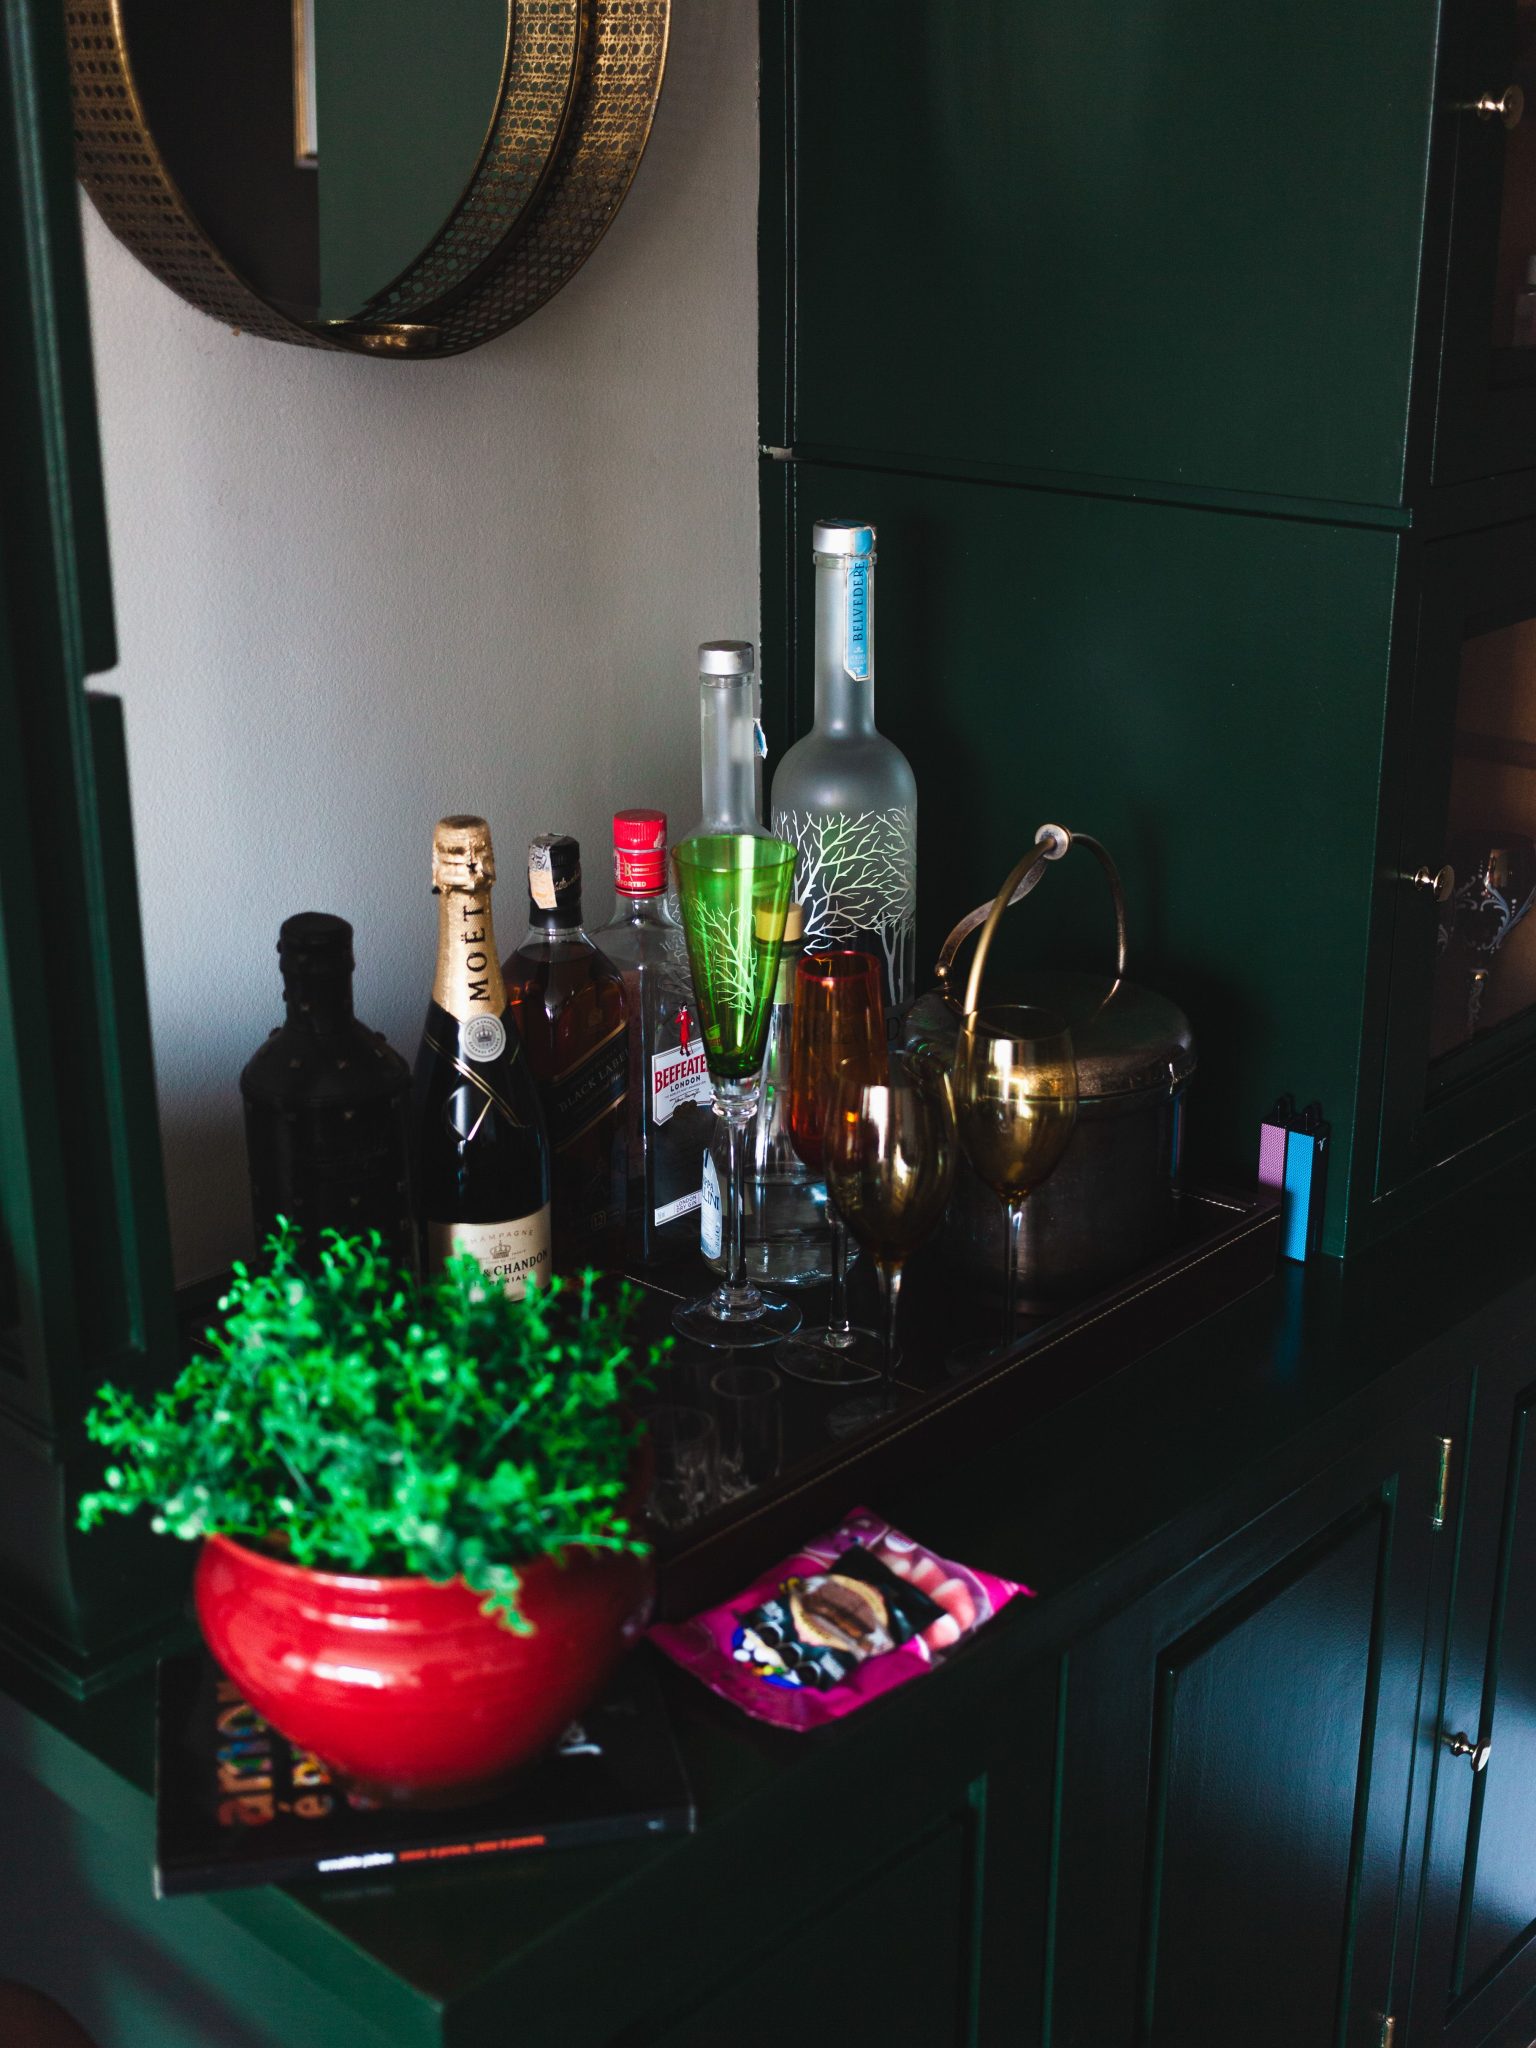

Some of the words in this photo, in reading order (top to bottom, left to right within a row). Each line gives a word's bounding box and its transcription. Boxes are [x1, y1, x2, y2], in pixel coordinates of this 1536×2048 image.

[853, 561, 866, 643] BELVEDERE
[461, 905, 491, 1002] MOËT
[654, 1053, 708, 1095] BEEFEATE
[670, 1074, 701, 1092] LONDON
[558, 1077, 597, 1113] BLACK
[469, 1229, 534, 1245] HAMPAGNE
[493, 1248, 548, 1277] CHANDON
